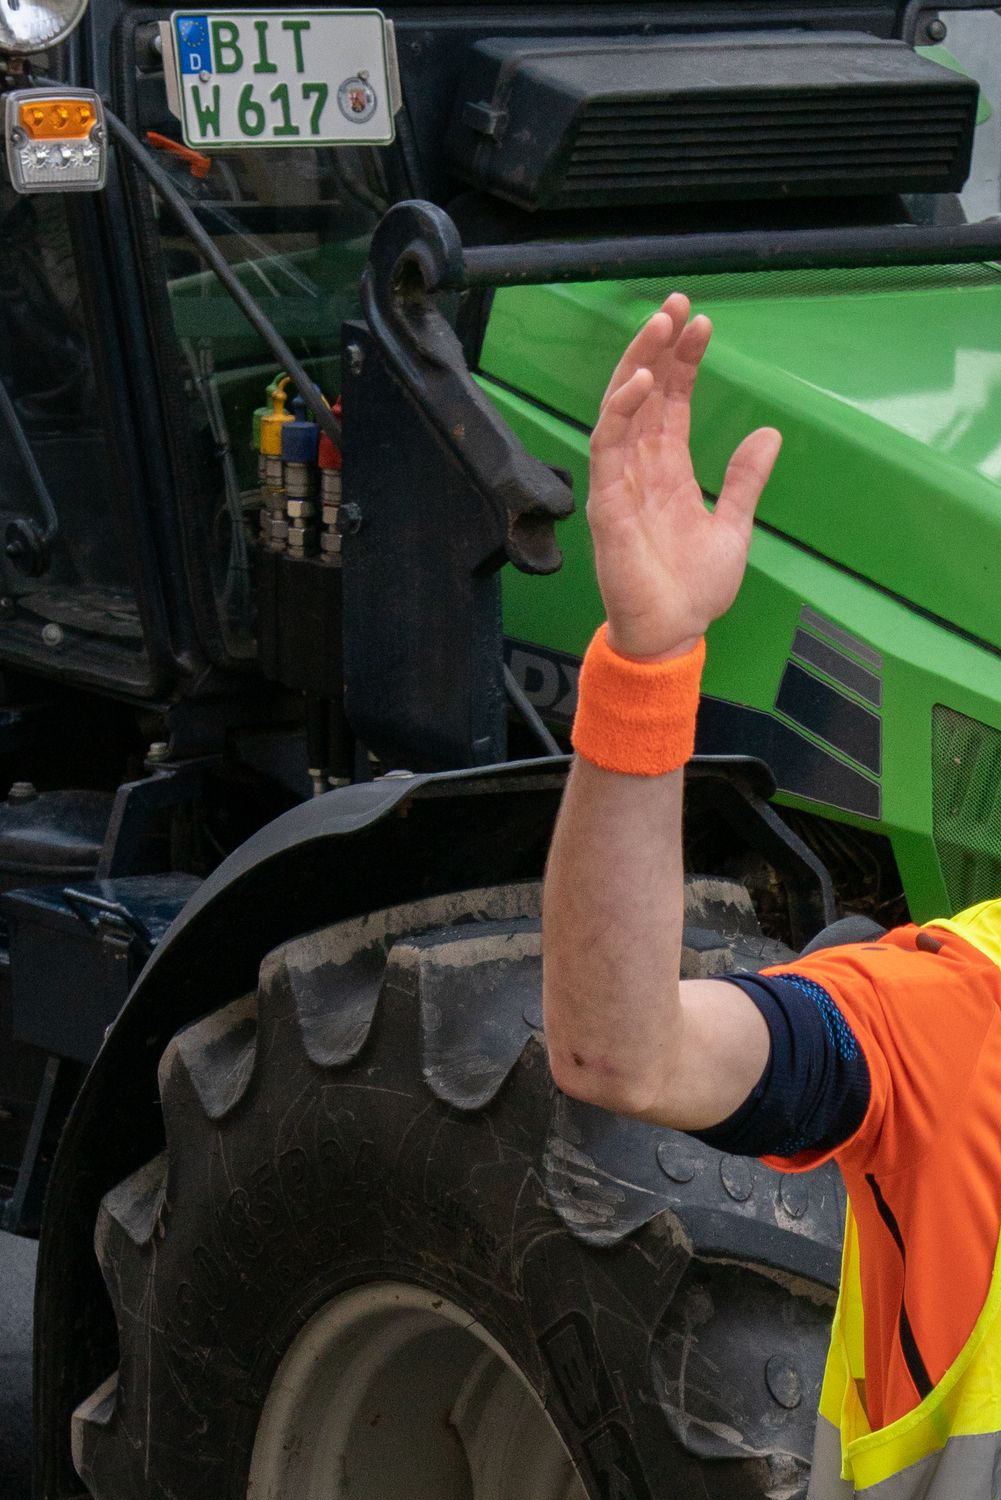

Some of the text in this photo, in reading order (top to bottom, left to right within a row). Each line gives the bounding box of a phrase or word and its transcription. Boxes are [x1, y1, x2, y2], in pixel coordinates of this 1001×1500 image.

[190, 53, 202, 71] D
[211, 20, 311, 74] BIT
[191, 83, 329, 137] W 617
